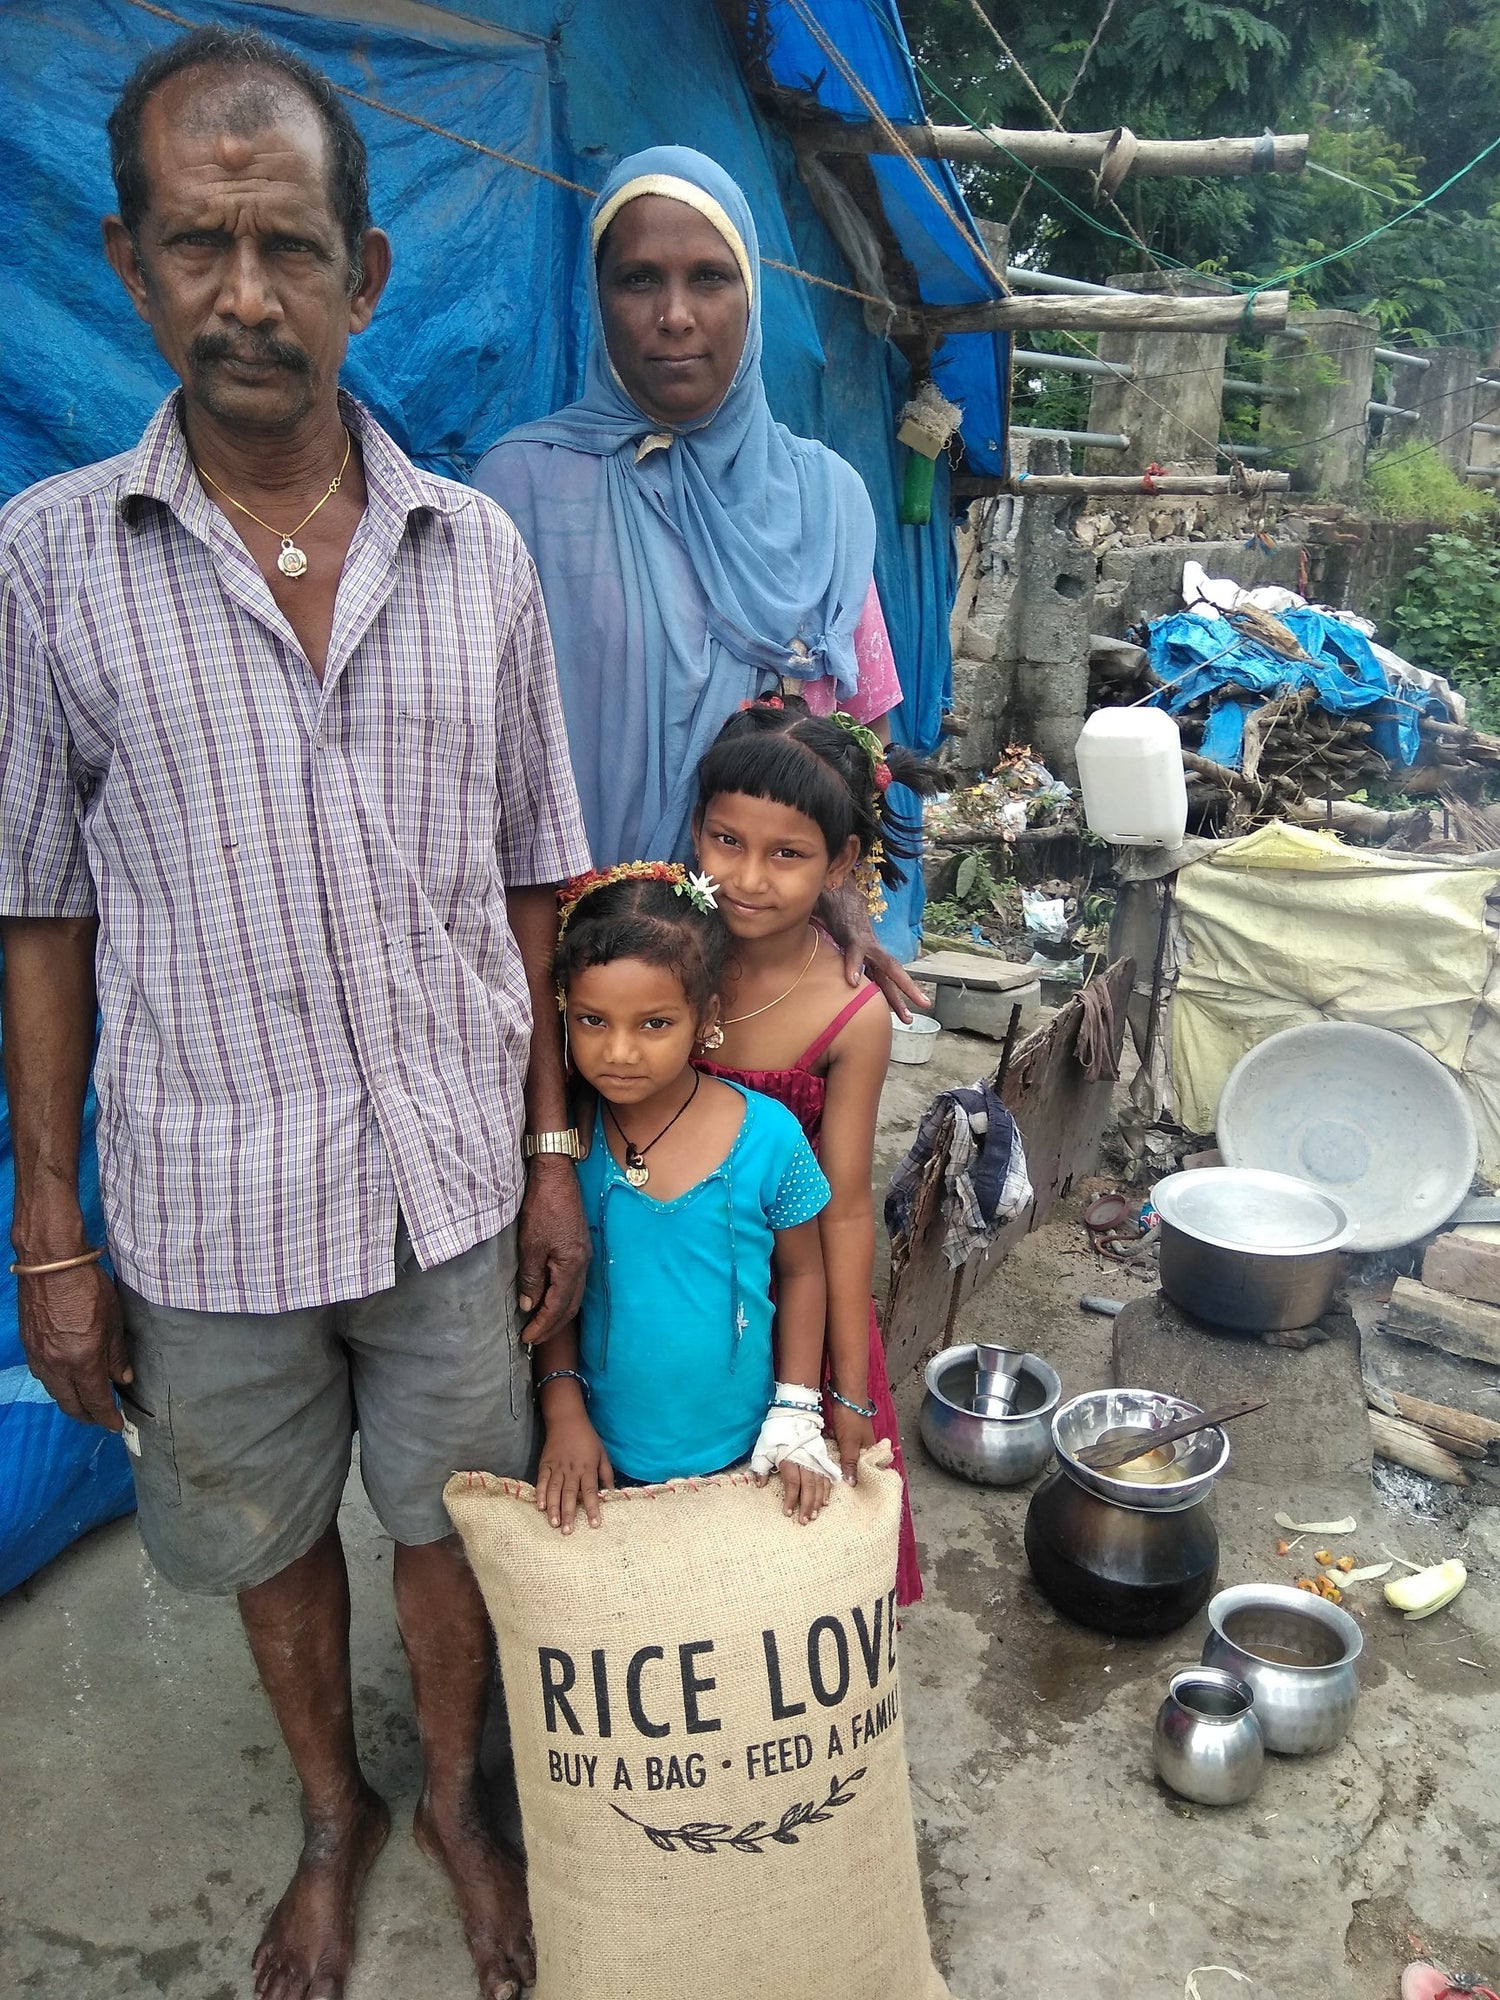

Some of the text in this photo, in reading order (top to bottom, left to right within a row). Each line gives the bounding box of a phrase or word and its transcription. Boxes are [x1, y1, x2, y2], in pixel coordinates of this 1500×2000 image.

[538, 1640, 722, 1739] RICE
[548, 1682, 898, 1791] BUY A BAG FEED A FAMIL
